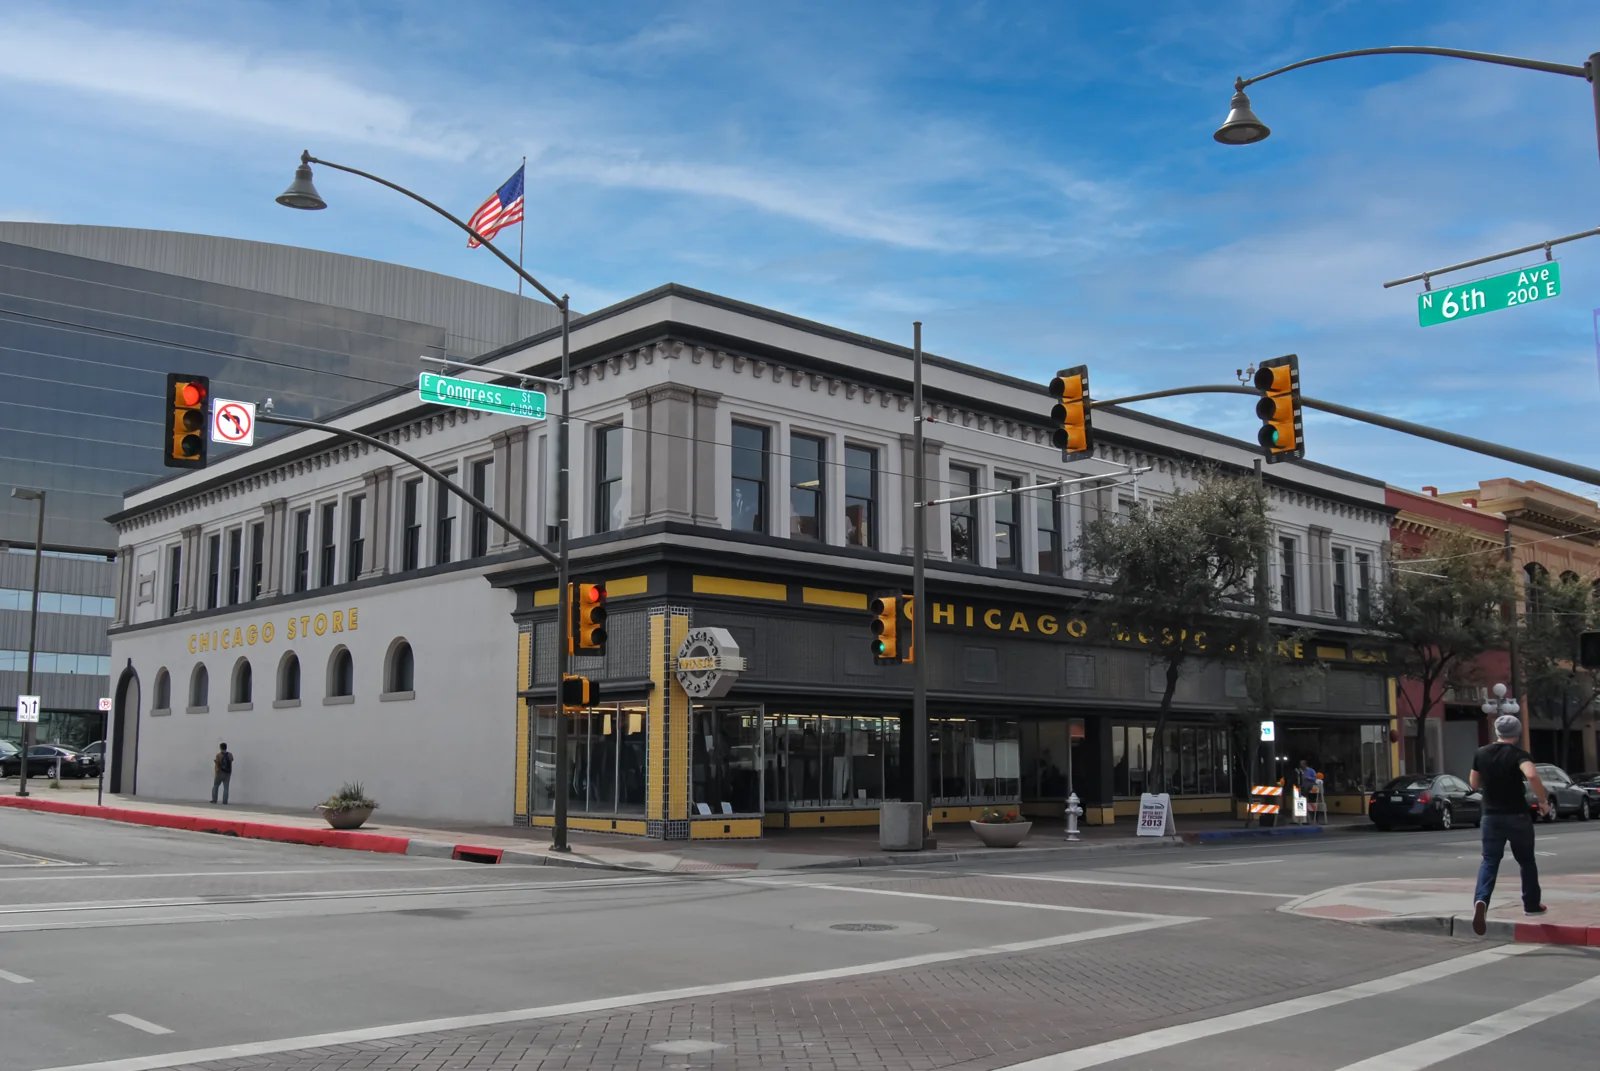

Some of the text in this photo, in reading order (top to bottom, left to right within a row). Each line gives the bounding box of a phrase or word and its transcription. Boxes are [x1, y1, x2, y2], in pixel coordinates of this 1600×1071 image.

[1517, 268, 1550, 287] Ave
[1423, 288, 1486, 318] N 6th
[1507, 281, 1557, 307] 200 E
[424, 376, 502, 407] E Congress
[521, 392, 531, 403] St
[188, 607, 358, 654] CHICAGO STORE
[680, 631, 718, 658] CHICAGO
[679, 657, 714, 669] MUSIC
[680, 671, 717, 693] STORE
